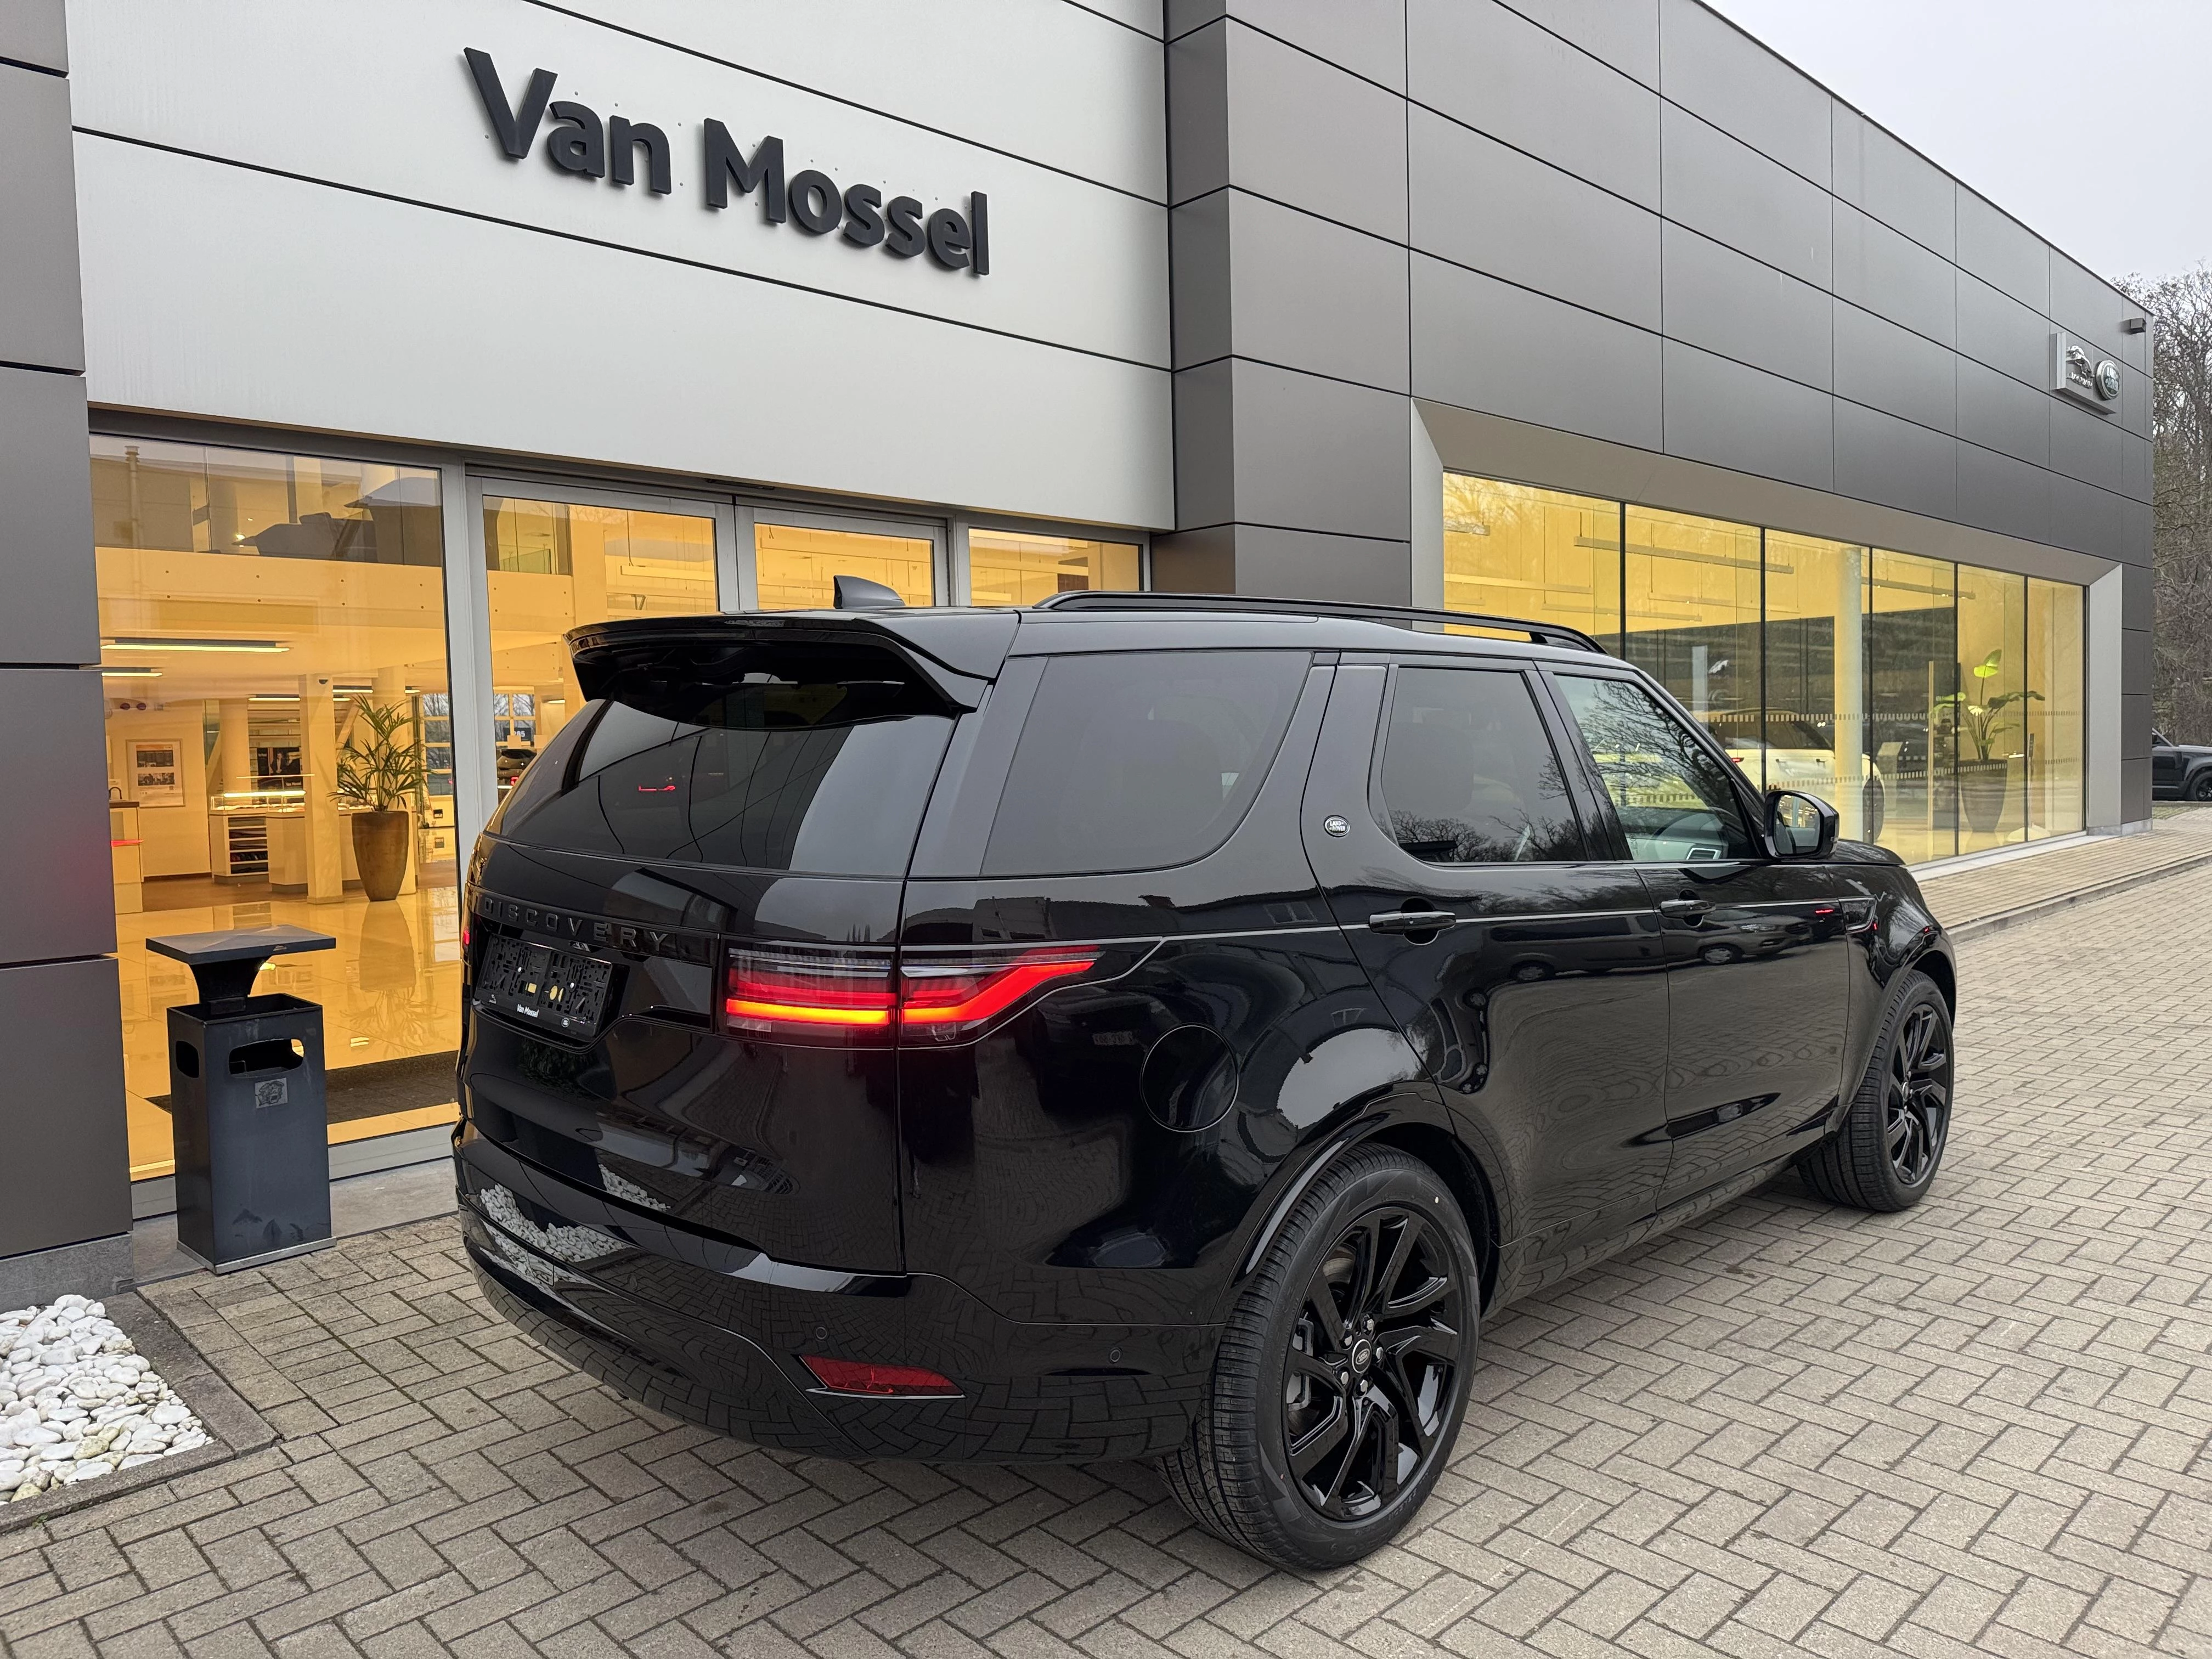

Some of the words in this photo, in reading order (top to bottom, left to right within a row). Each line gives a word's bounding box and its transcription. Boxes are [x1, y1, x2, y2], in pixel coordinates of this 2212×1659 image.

[464, 47, 672, 194] Van
[704, 118, 989, 275] Mossel
[484, 898, 668, 952] DISCOVERY
